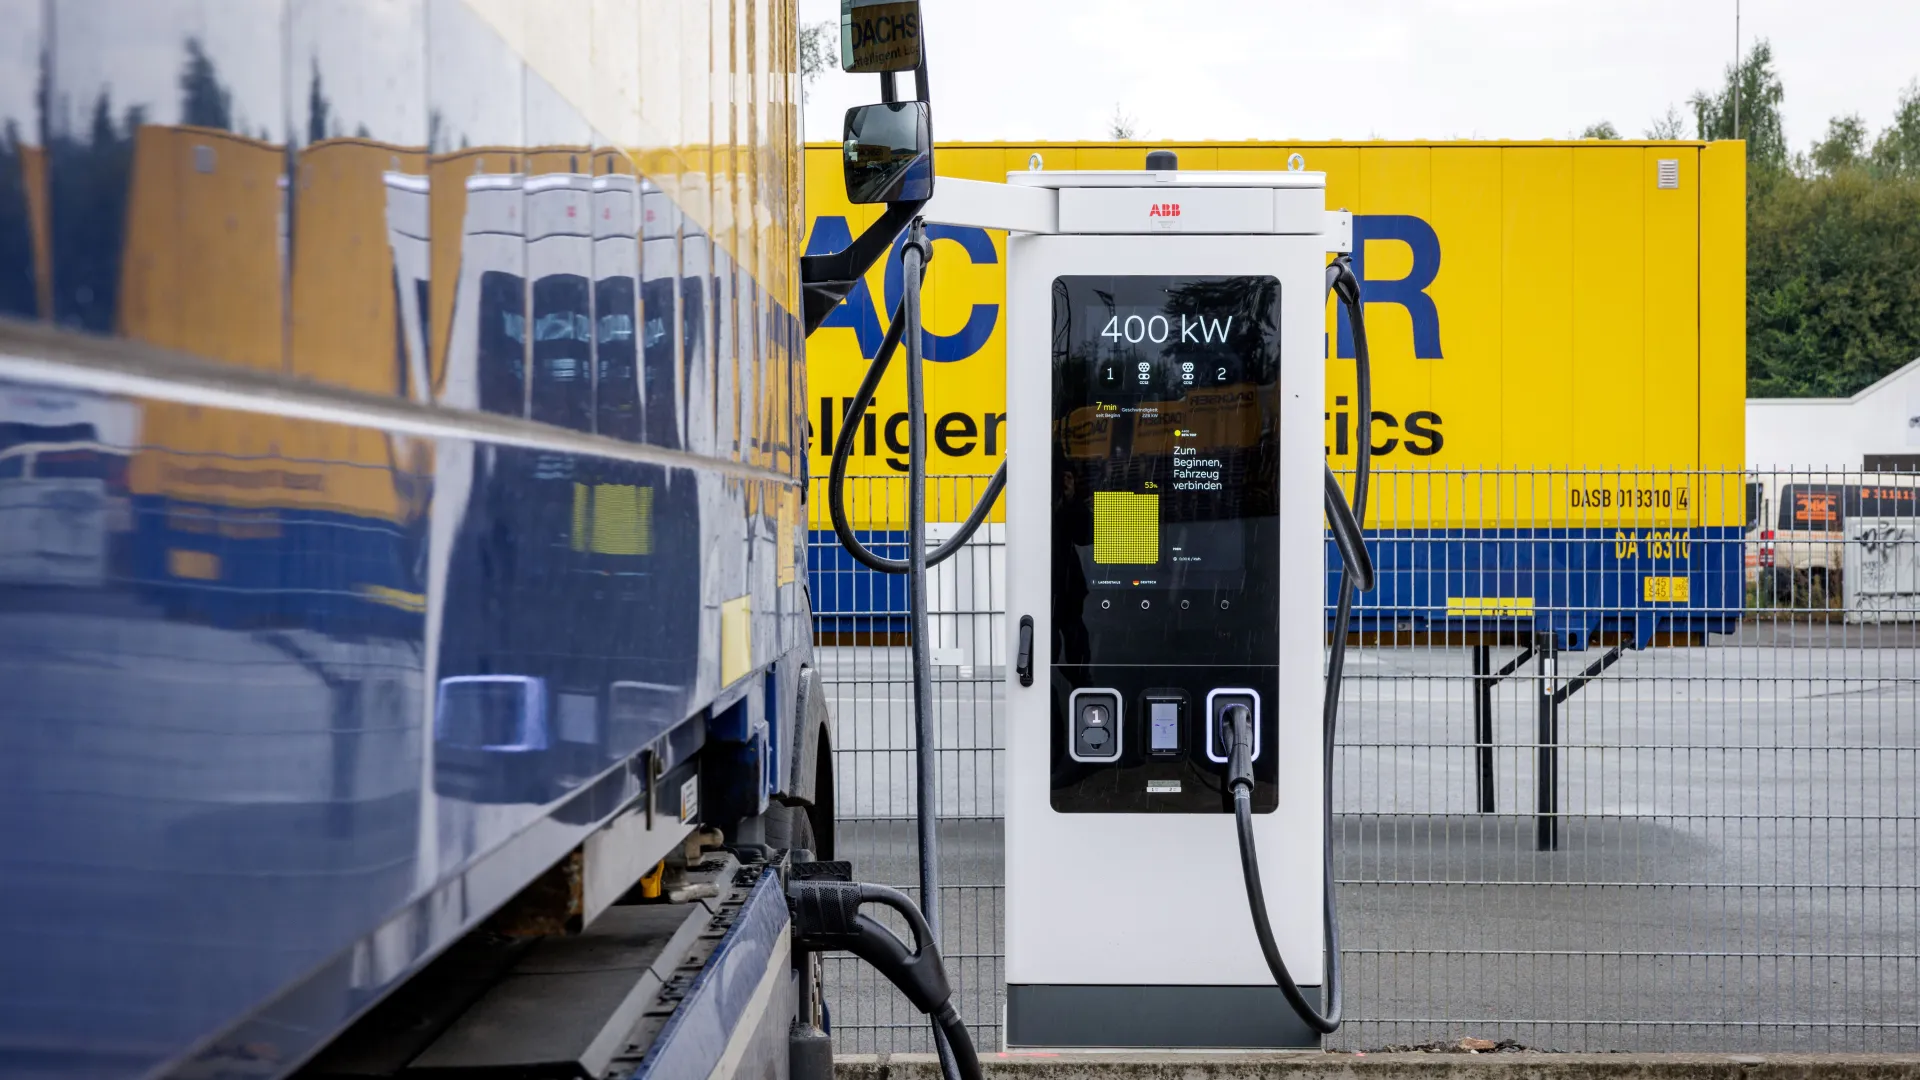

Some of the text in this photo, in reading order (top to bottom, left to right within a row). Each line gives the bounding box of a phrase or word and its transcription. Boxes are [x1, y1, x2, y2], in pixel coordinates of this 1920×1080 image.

[1149, 203, 1181, 217] ABB
[1101, 314, 1233, 344] 400 kW
[1106, 367, 1114, 380] 1
[1217, 367, 1226, 380] 2
[1095, 401, 1117, 411] 7 min
[1173, 446, 1196, 456] Zum
[1173, 457, 1223, 468] Beginnen,
[1173, 469, 1219, 481] Fahrzeug
[1173, 480, 1223, 490] verbinden
[1571, 489, 1611, 507] DASB
[1615, 531, 1639, 559] DA
[1091, 709, 1102, 723] 1
